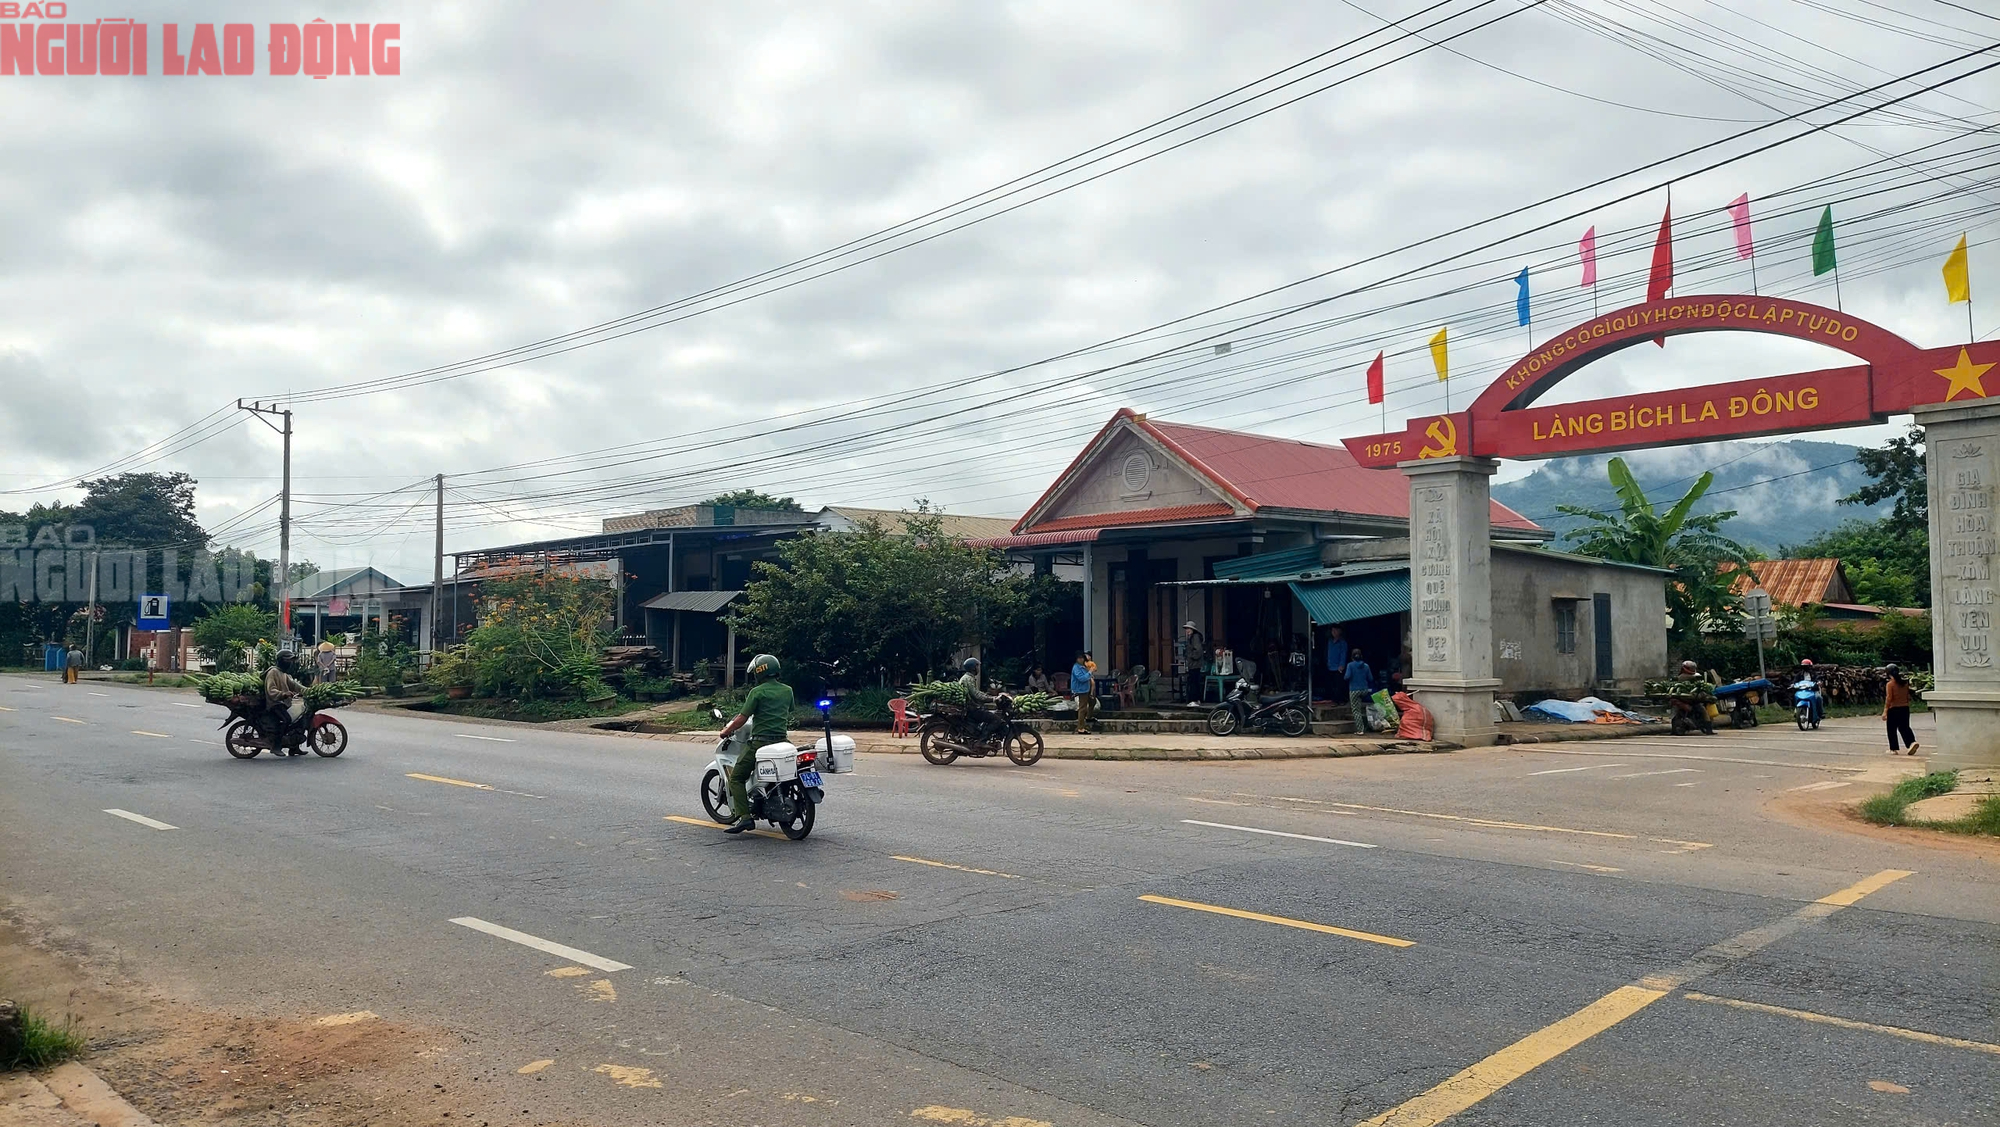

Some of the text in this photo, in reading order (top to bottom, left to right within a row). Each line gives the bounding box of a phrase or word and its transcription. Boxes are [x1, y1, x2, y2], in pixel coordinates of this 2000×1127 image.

[1532, 387, 1818, 440] LÀNG BÍCH LA ĐÔNG
[1365, 440, 1402, 458] 1975
[1956, 468, 1981, 486] GIA
[1950, 490, 1988, 511] ĐÌNH
[1956, 514, 1986, 534] HÒA
[1947, 534, 1996, 558] THUẬN
[1958, 632, 1987, 651] VUI
